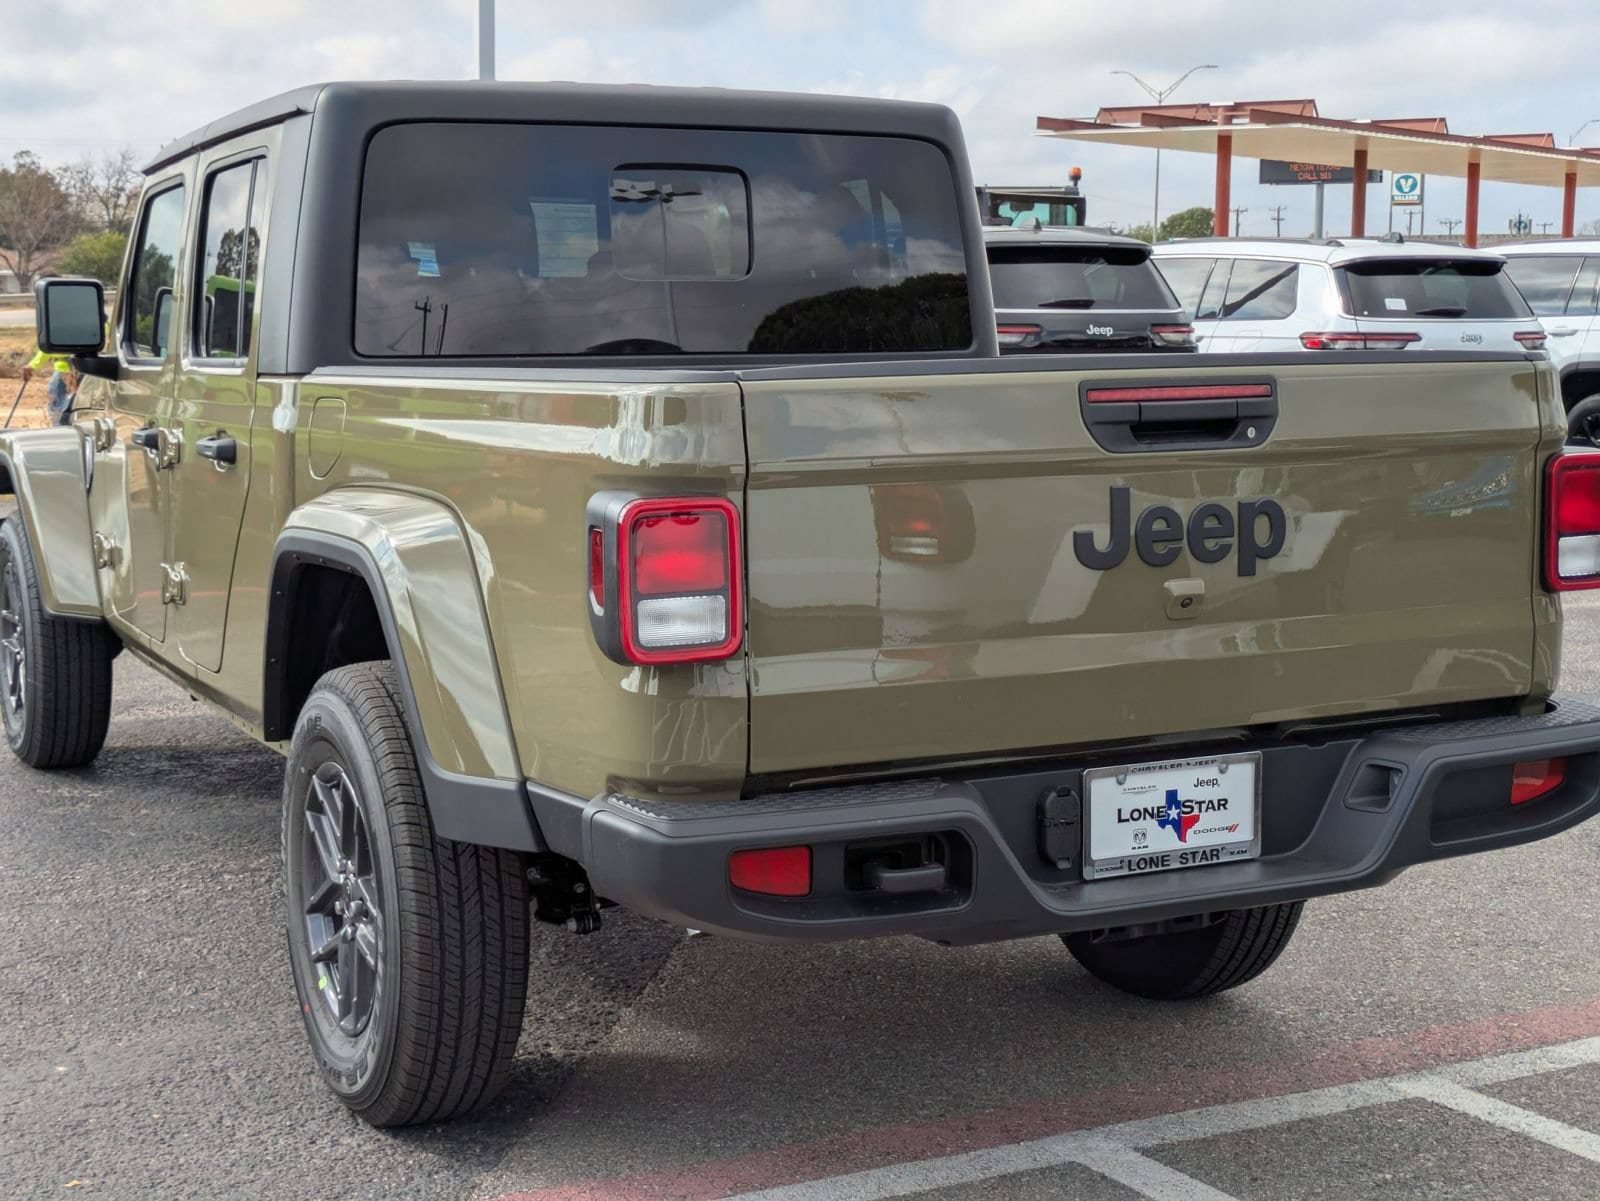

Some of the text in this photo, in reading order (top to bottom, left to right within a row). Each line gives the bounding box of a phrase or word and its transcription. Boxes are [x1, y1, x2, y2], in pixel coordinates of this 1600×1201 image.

[1297, 172, 1318, 180] CALL
[1086, 324, 1113, 337] Jeep
[1460, 331, 1482, 345] Jeep
[1073, 485, 1287, 577] Jeep
[1131, 758, 1218, 773] CHRYSLER JEEP
[1193, 777, 1219, 788] Jeep
[1117, 798, 1229, 824] LONE STAR
[1193, 825, 1232, 835] DODGE
[1128, 848, 1220, 872] LONE STAR
